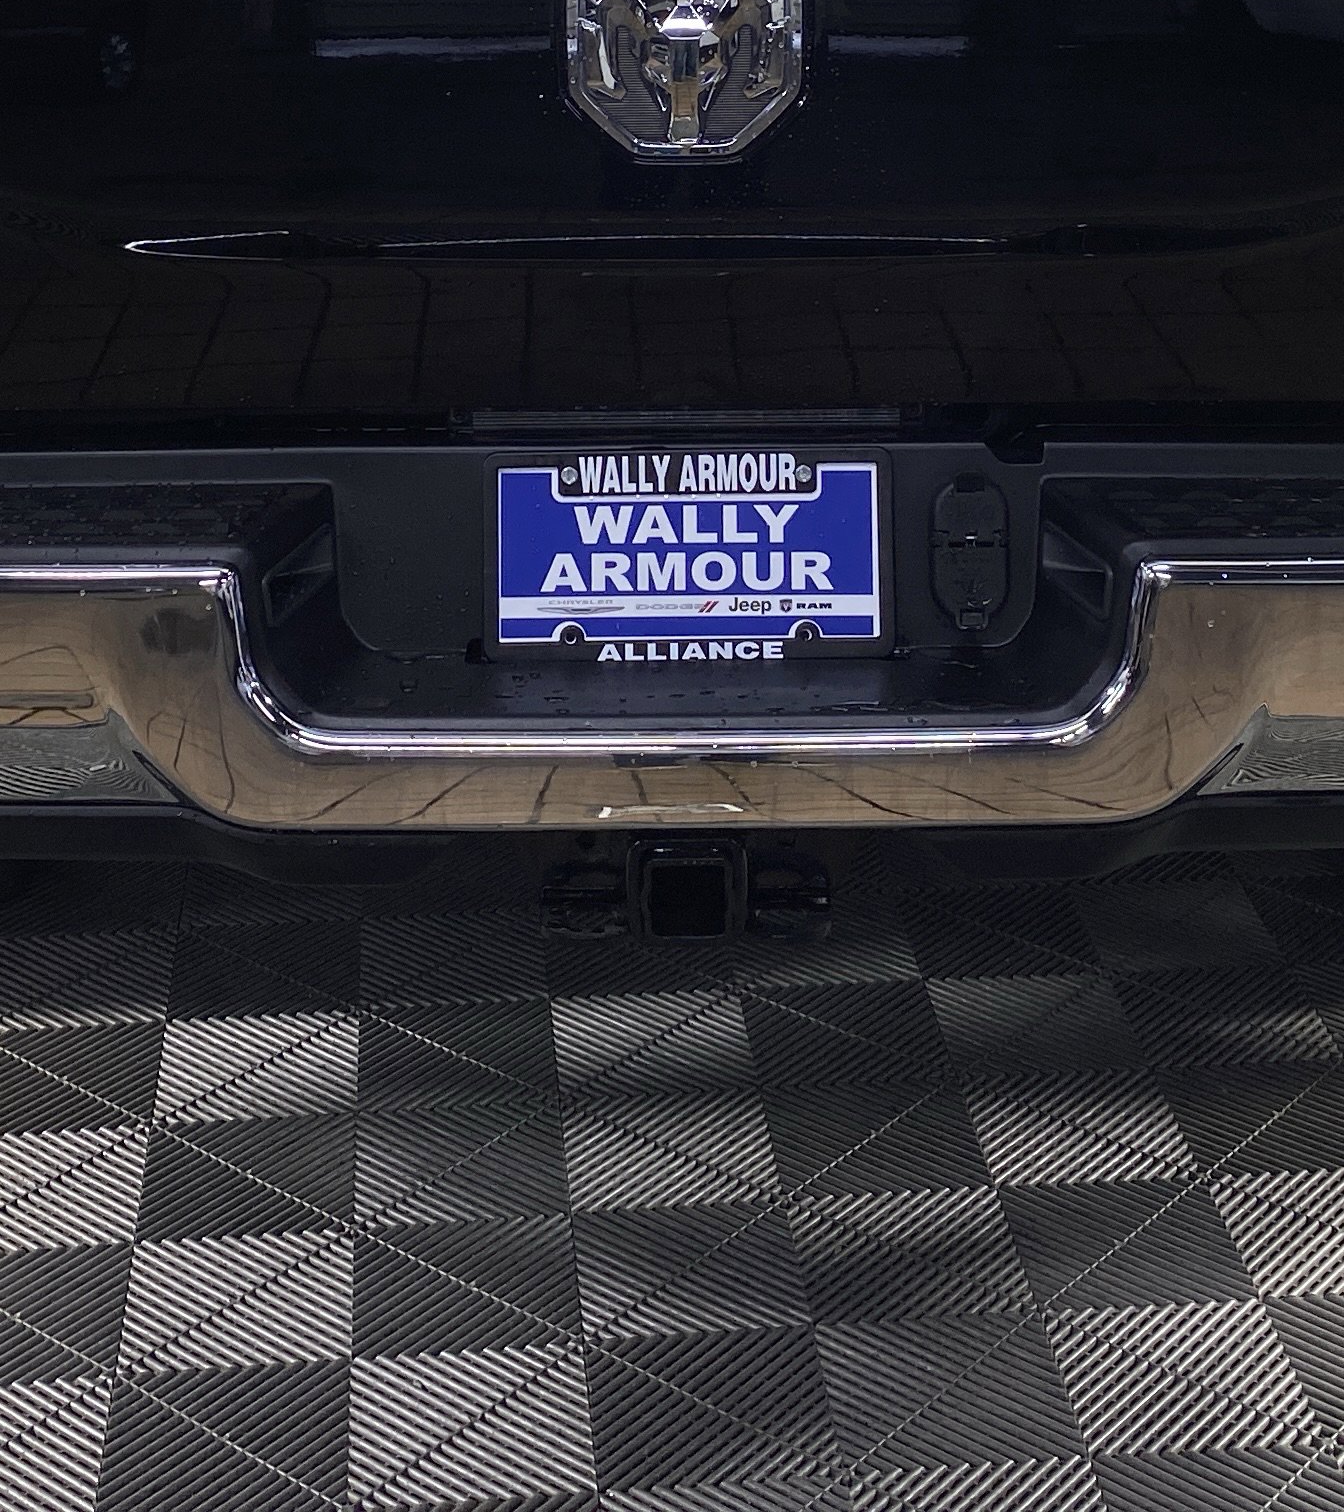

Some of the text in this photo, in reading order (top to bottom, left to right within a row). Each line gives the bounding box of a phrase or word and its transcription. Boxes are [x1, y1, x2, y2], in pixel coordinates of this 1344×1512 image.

[578, 453, 797, 493] WALLY ARMOUR
[574, 504, 799, 545] WALLY
[540, 551, 834, 593] ARMOUR
[728, 597, 772, 615] Jeep
[597, 641, 784, 662] ALLIANCE
